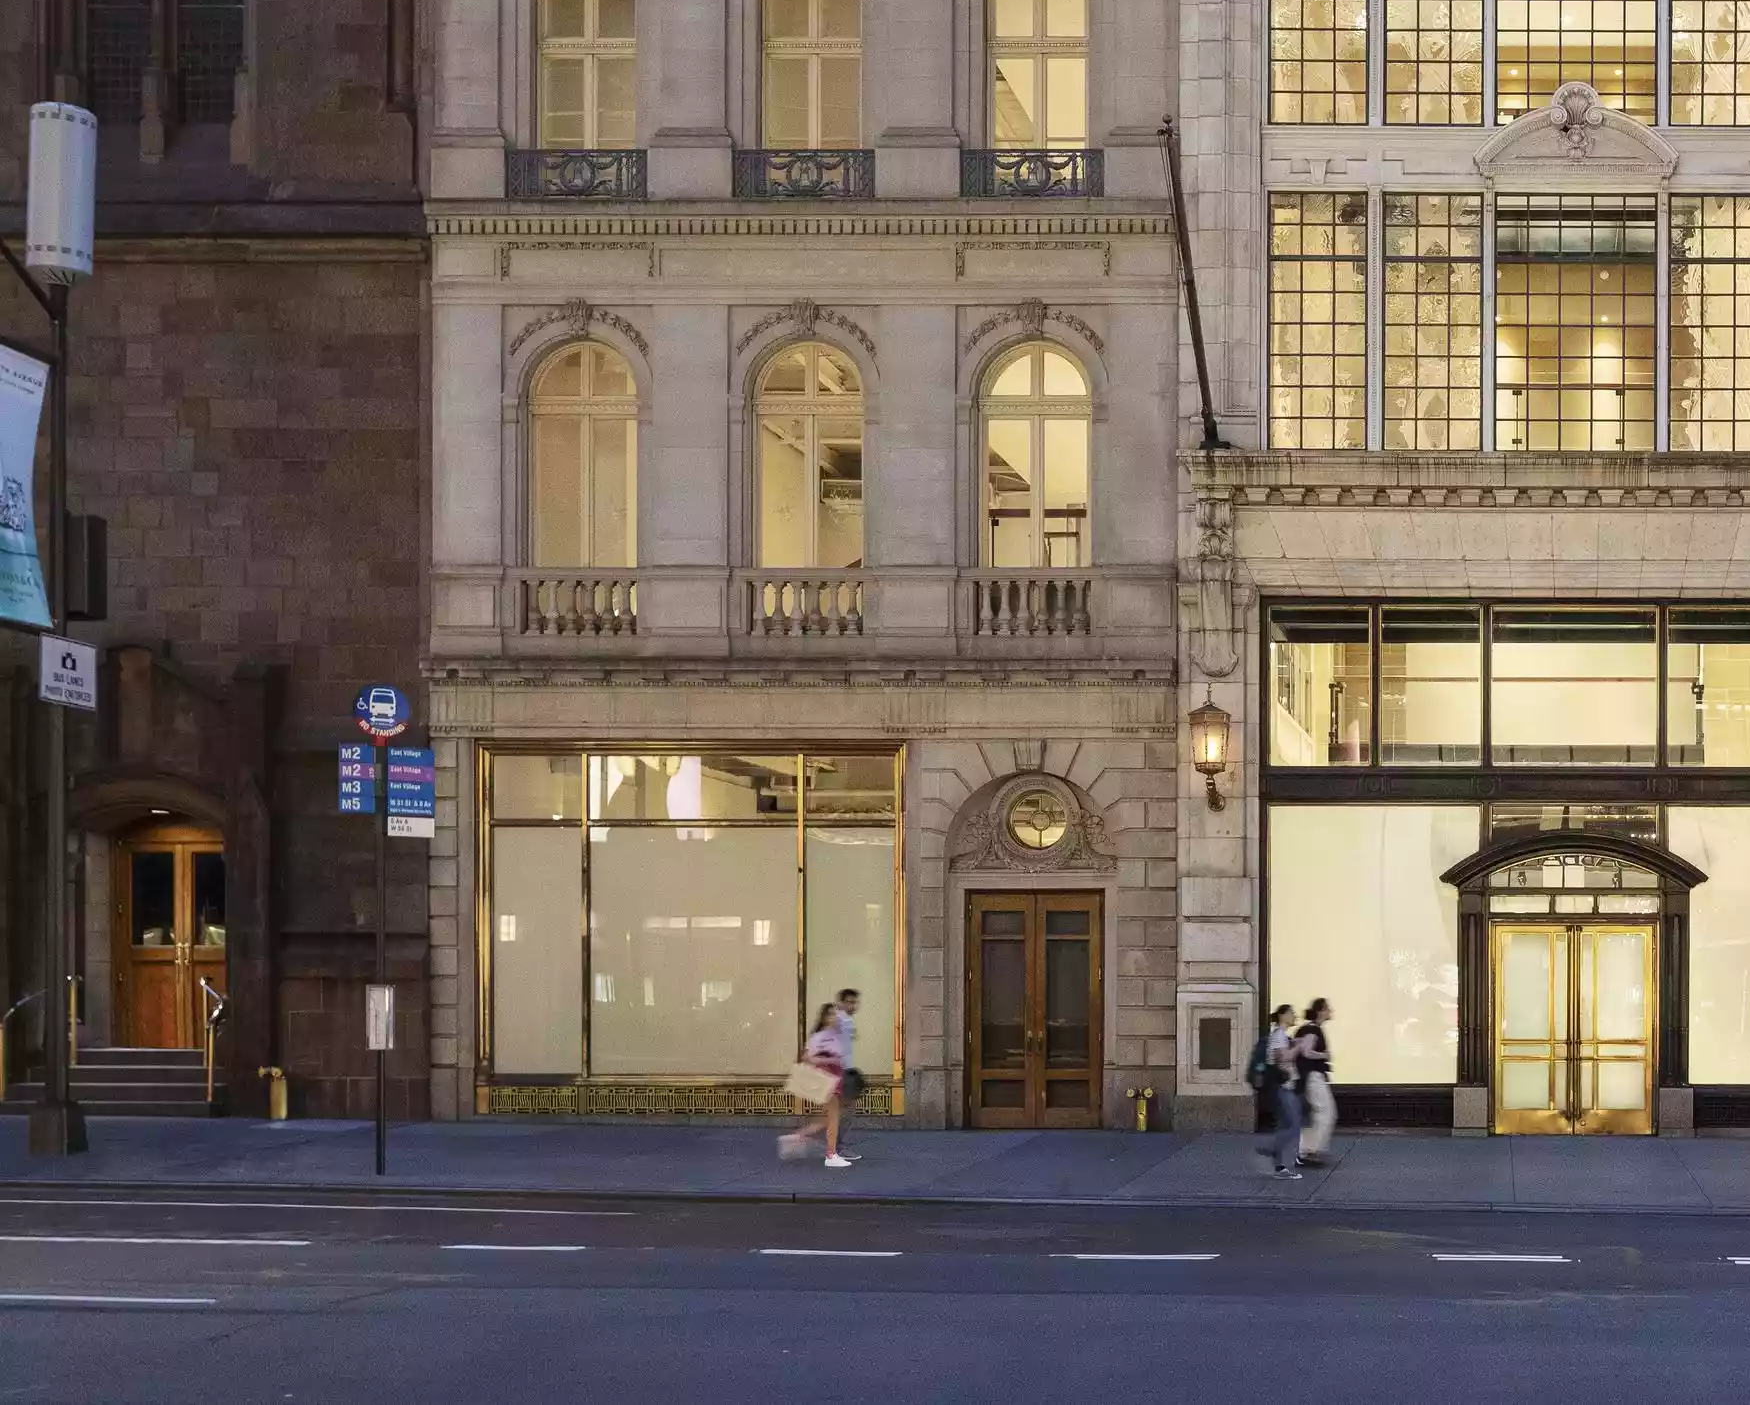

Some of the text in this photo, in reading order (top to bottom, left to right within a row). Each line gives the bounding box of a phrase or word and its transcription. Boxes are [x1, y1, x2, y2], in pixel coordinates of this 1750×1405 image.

[359, 719, 370, 731] NO
[370, 724, 405, 736] STANDING
[341, 747, 361, 759] M2
[391, 749, 421, 758] East Village
[342, 764, 361, 776] M2
[341, 782, 361, 794] M3
[341, 798, 361, 811] M5
